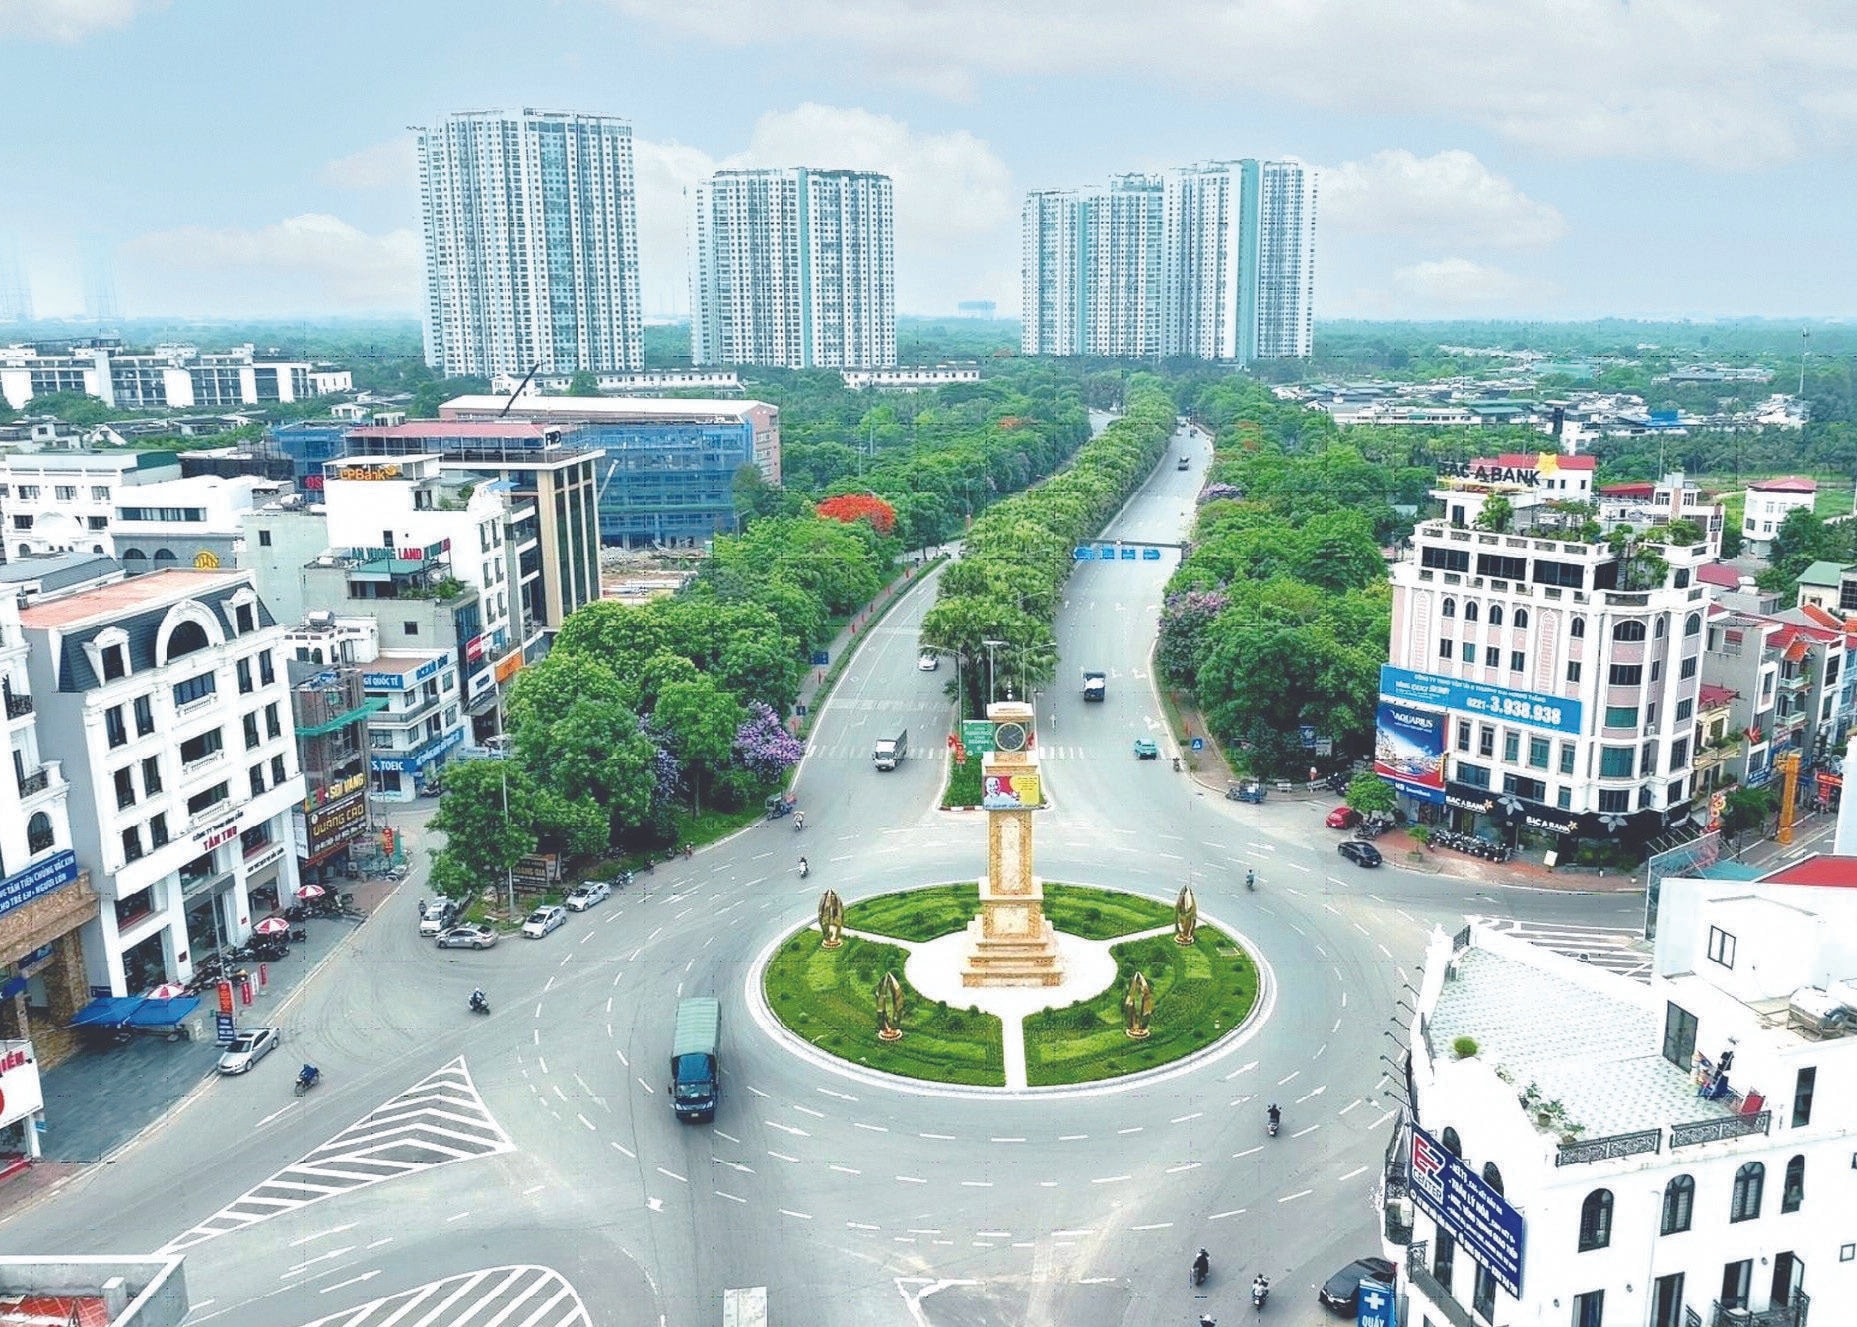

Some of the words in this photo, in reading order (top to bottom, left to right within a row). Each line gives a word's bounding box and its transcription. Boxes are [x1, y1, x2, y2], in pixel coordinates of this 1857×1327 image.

[1491, 466, 1541, 486] BANK
[381, 761, 404, 771] TOEIC
[1548, 822, 1571, 833] BANK
